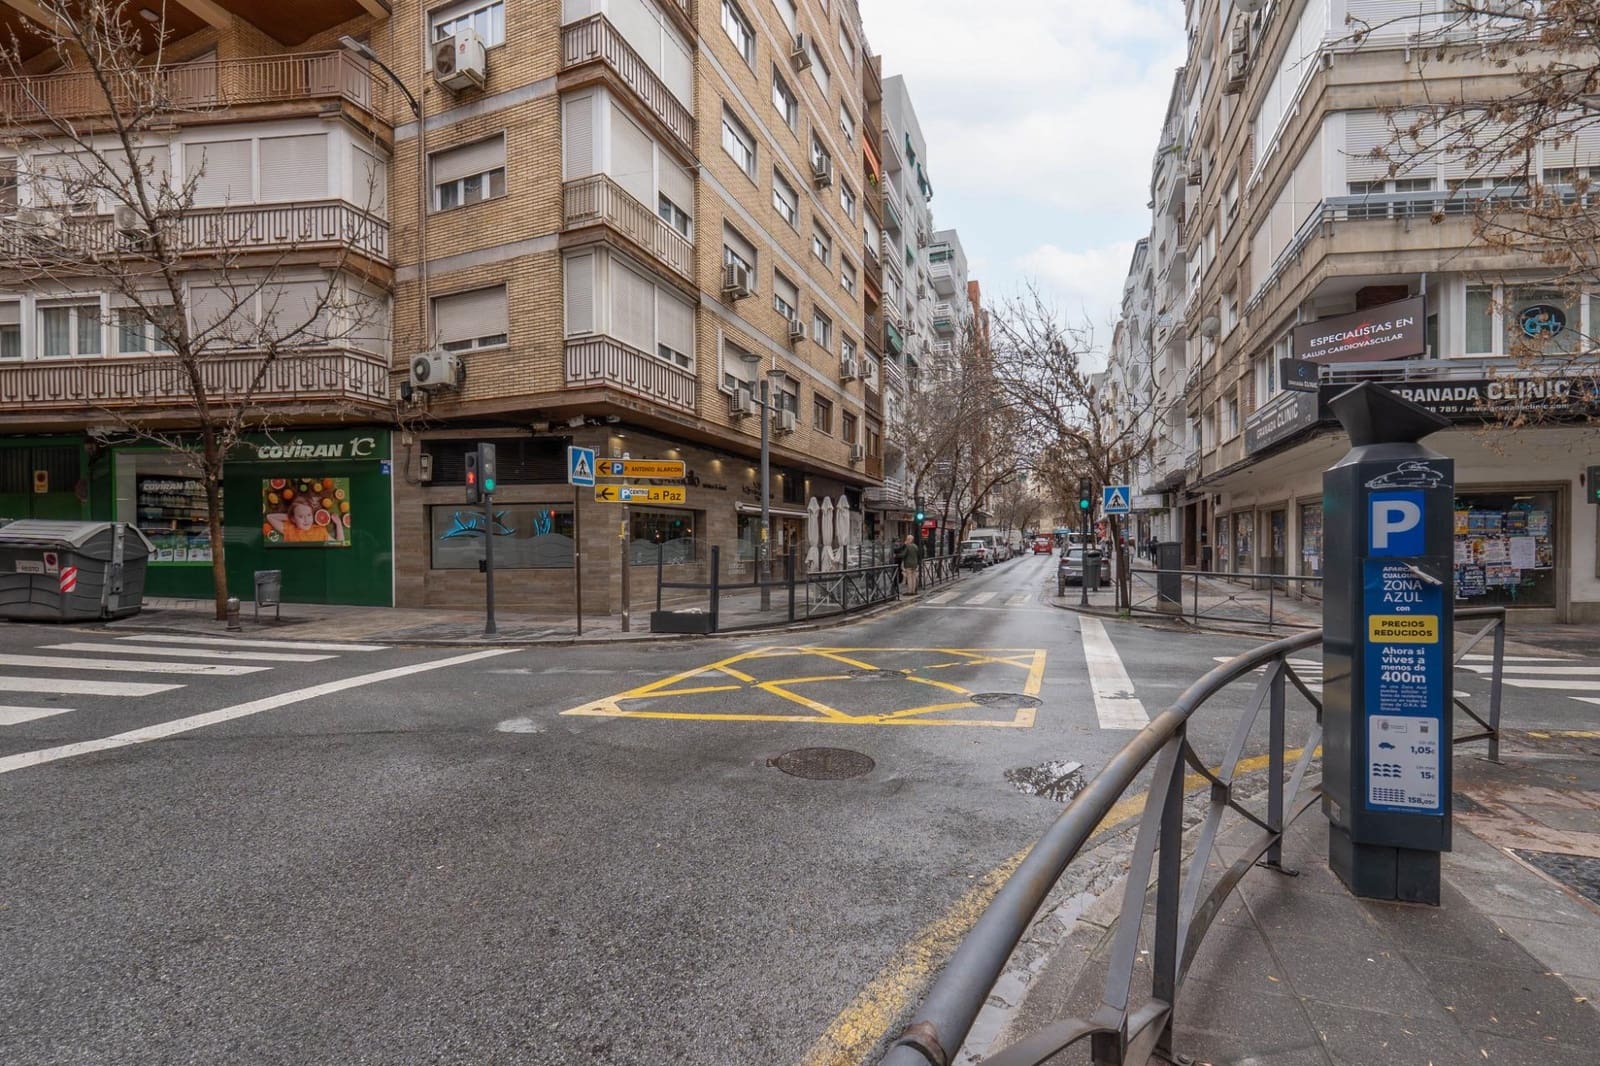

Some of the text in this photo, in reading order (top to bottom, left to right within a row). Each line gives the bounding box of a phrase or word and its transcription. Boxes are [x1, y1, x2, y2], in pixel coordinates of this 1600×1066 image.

[1310, 316, 1414, 347] ESPECIALISTAS EN
[1301, 333, 1404, 359] SALUD CARDIOVASCULAR
[1487, 380, 1570, 400] CLINIC
[1276, 402, 1299, 428] CLINIC
[631, 465, 656, 473] ANTONIO
[647, 490, 682, 501] La Paz
[1372, 500, 1421, 549] P
[1383, 580, 1423, 591] ZONA
[1383, 591, 1424, 603] AZUL
[1381, 620, 1425, 628] PRECIOS
[1374, 629, 1433, 637] REDUCIDOS
[1382, 646, 1425, 655] Ahora si
[1381, 654, 1414, 664] vives
[1381, 671, 1426, 683] 400m
